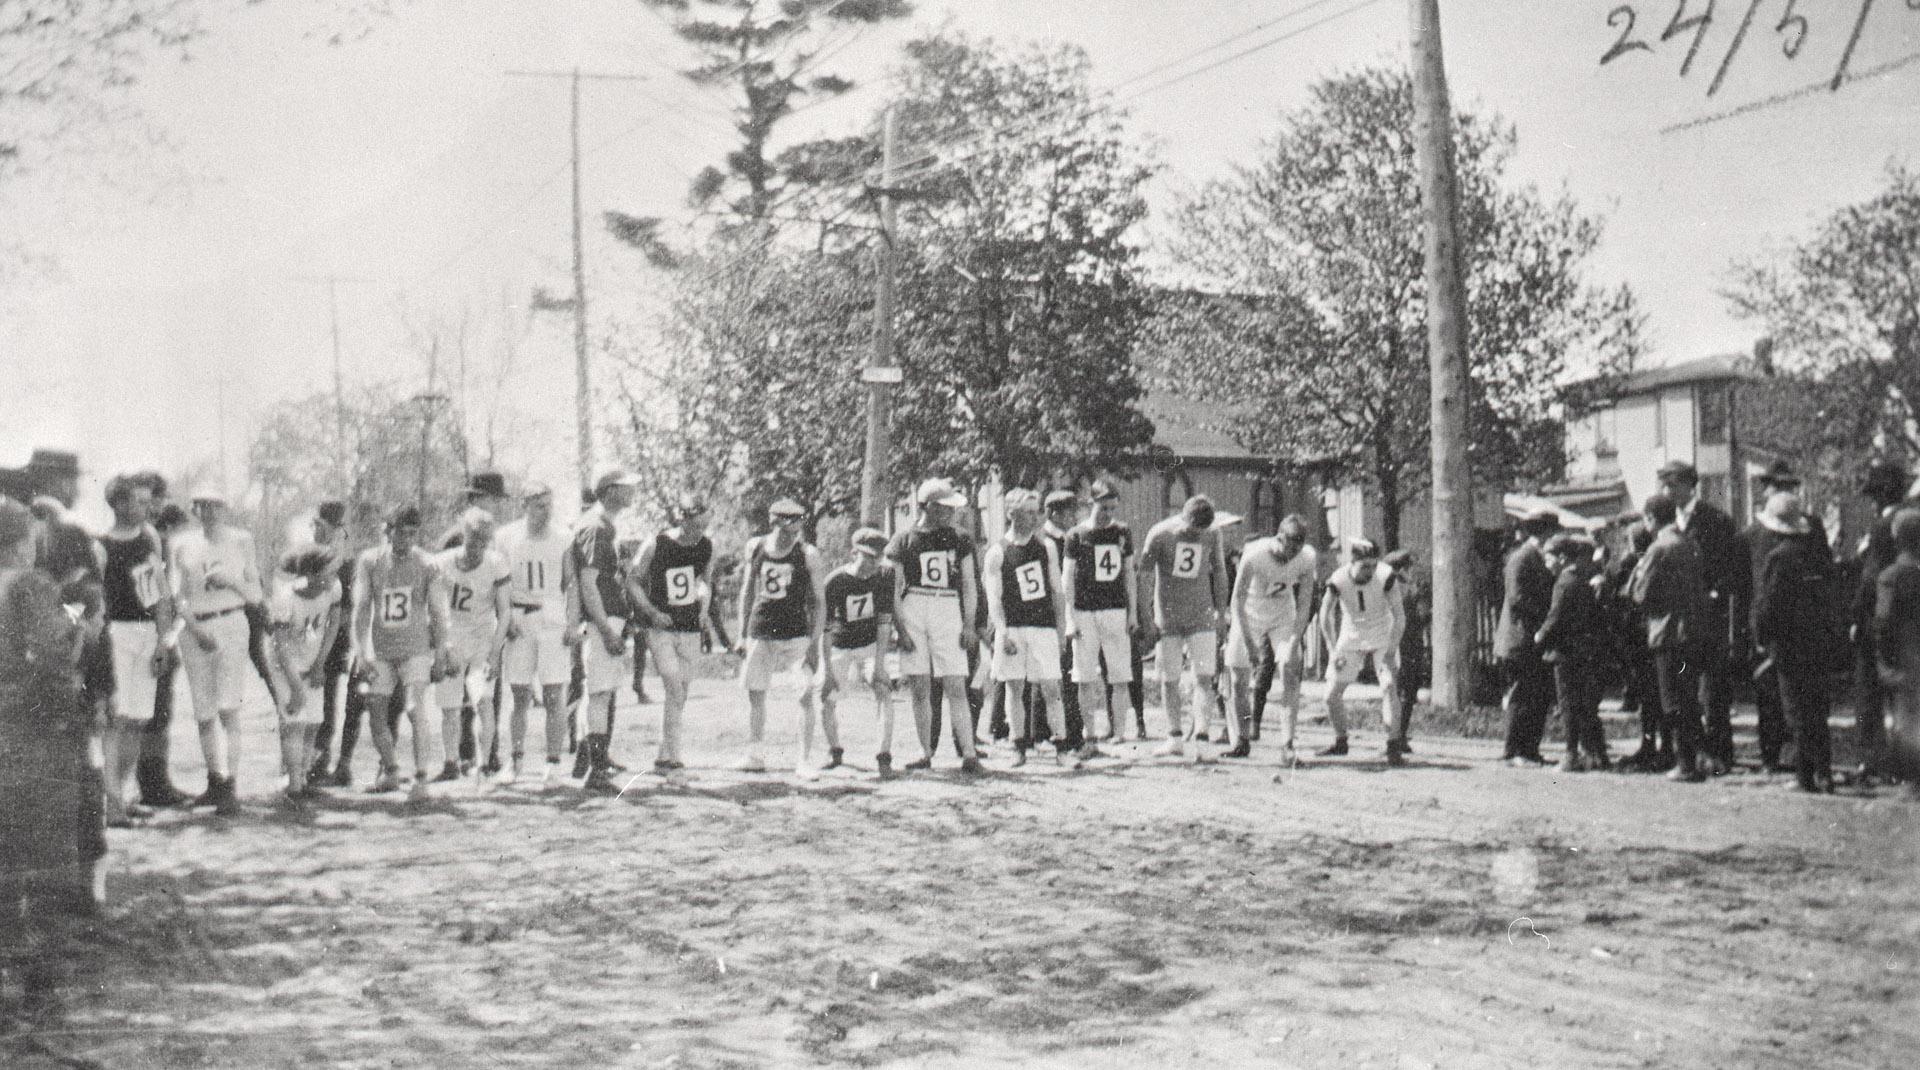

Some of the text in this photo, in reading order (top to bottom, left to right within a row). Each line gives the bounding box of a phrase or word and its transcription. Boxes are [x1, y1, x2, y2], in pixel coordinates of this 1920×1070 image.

[927, 557, 942, 581] 6
[1098, 550, 1117, 575] 4
[1179, 547, 1195, 572] 3
[527, 561, 544, 590] 11
[673, 572, 689, 599] 9
[765, 568, 780, 594] 8
[1022, 567, 1040, 593] 5
[451, 583, 474, 612] 12
[1265, 582, 1287, 598] 2
[1357, 589, 1366, 612] 1
[384, 592, 408, 621] 13
[852, 597, 868, 617] 7
